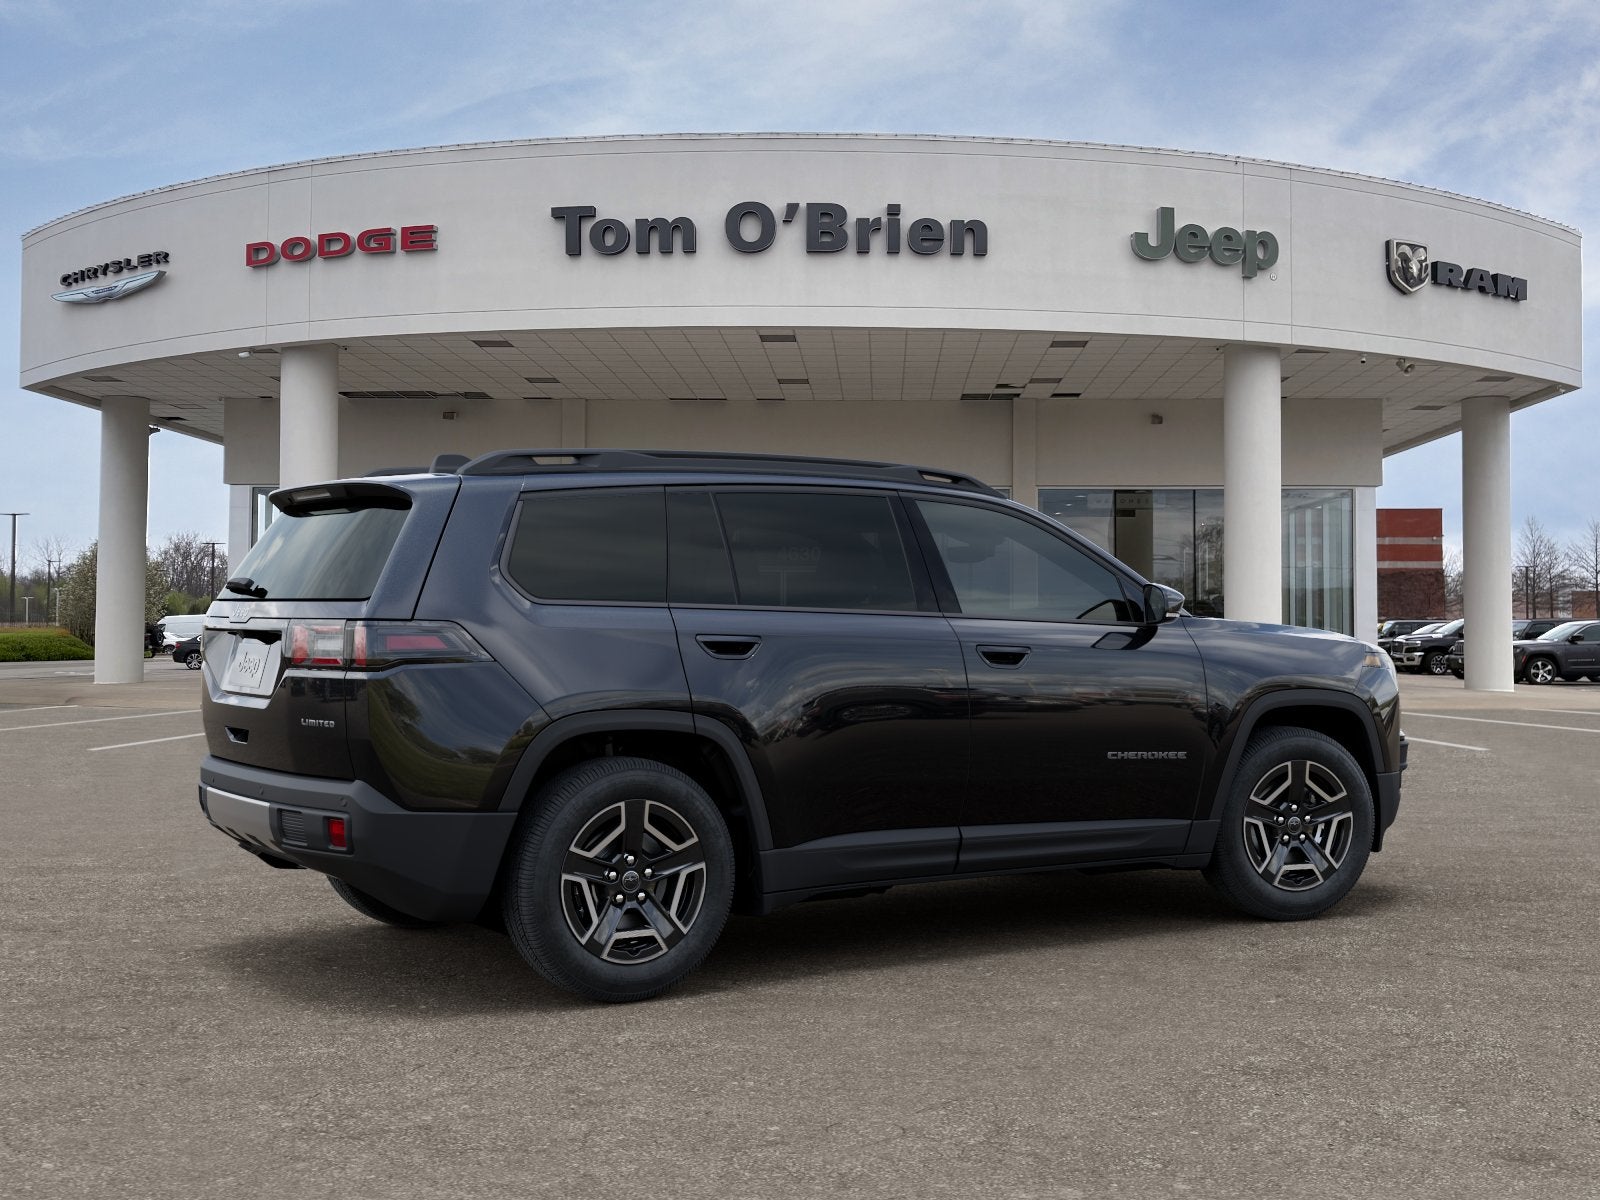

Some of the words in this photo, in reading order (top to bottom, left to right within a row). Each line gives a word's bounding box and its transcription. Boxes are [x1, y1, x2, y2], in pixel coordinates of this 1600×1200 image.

[245, 224, 439, 268] DODGE
[551, 205, 697, 256] Tom
[724, 201, 989, 256] O'Brien
[1130, 206, 1280, 279] Jeep
[60, 250, 170, 286] CHRYSLER
[1430, 261, 1528, 302] RAM
[300, 717, 336, 729] LIMITED
[1107, 751, 1188, 760] CHEROKEE
